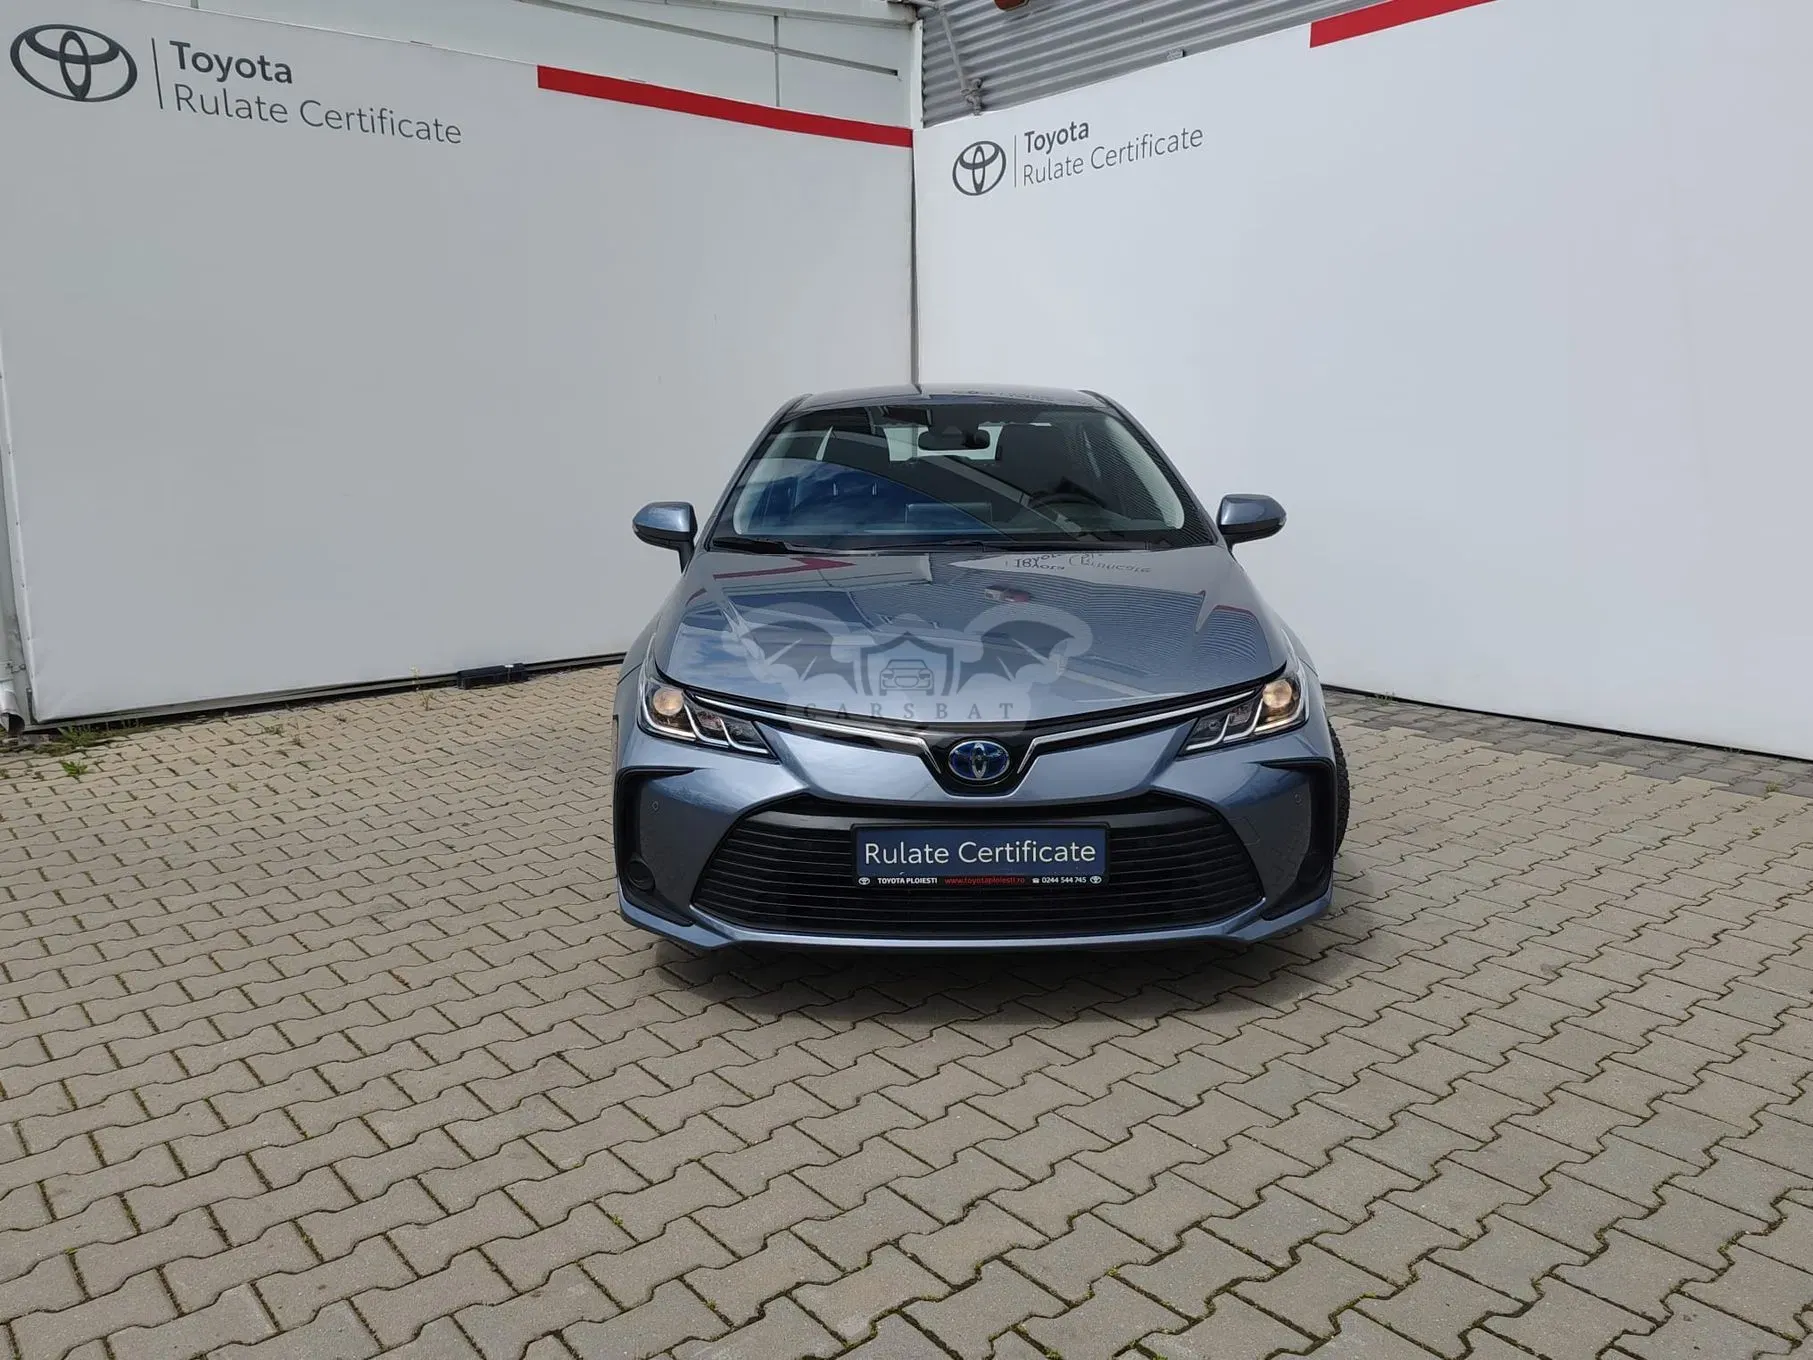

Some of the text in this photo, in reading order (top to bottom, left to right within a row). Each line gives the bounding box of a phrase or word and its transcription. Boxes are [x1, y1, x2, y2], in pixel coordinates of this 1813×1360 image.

[170, 40, 293, 84] Toyota
[174, 83, 462, 144] Rulate Certificate
[1023, 127, 1204, 186] Rulate Certificate
[1024, 121, 1090, 154] Toyota
[865, 840, 1096, 864] Rulate Certificate
[1074, 876, 1087, 884] 745
